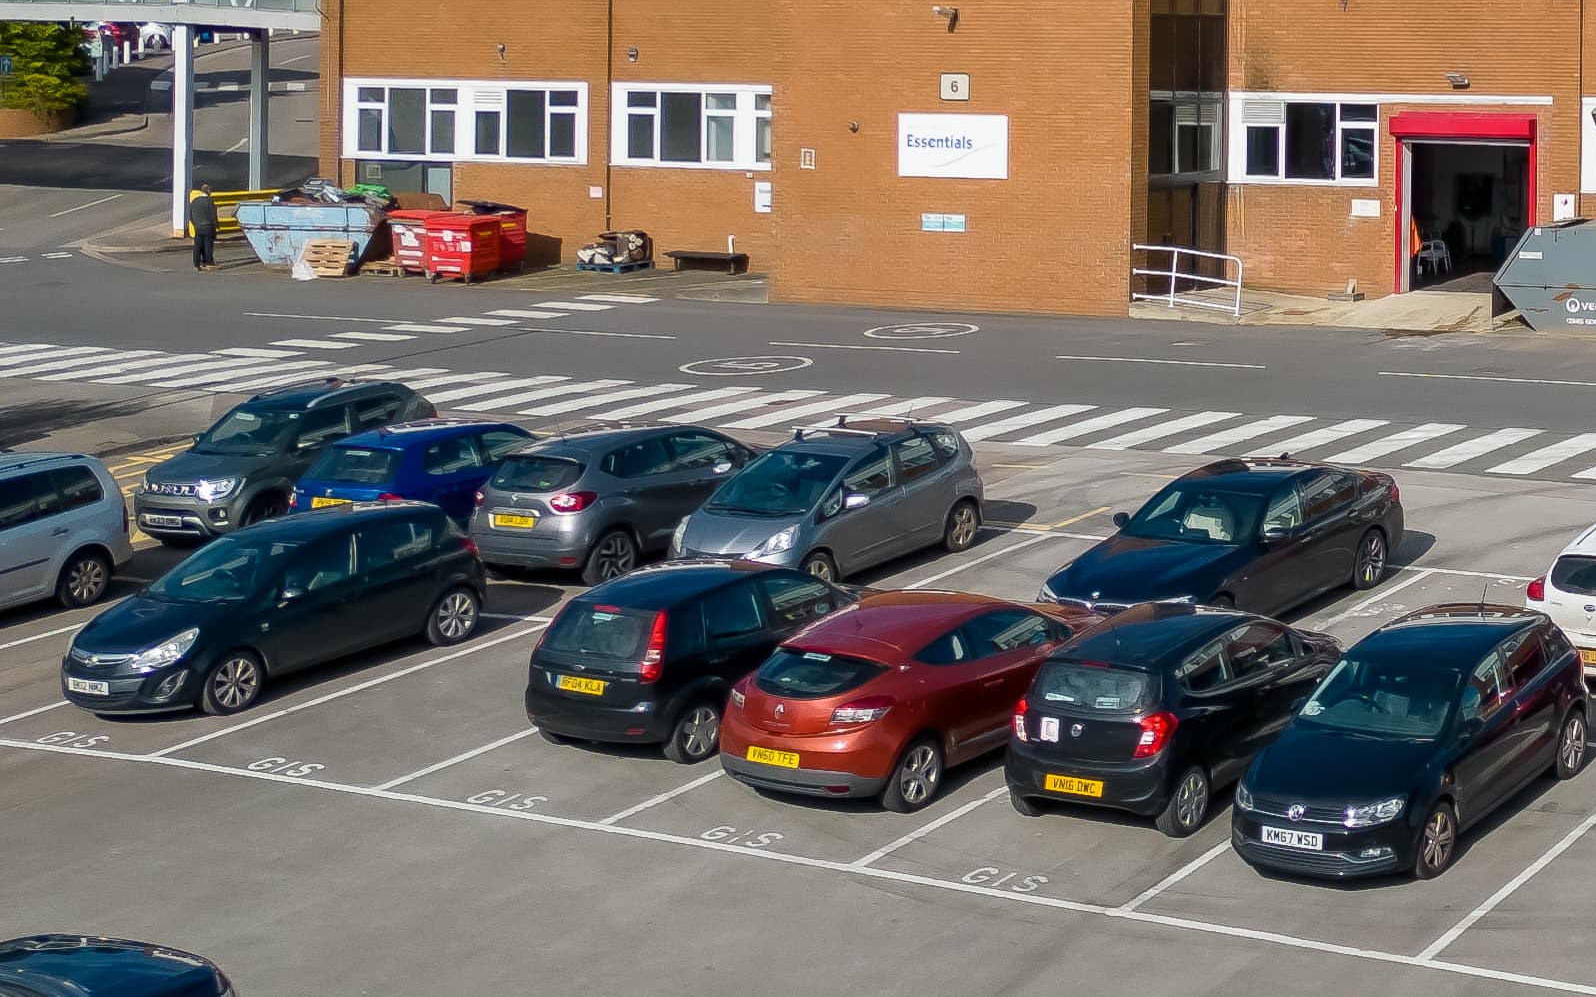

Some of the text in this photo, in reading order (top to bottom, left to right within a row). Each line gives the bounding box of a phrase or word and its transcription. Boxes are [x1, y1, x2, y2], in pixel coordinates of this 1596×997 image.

[950, 80, 959, 93] 6
[906, 134, 973, 150] Essentials
[778, 752, 796, 765] TFE
[1053, 777, 1075, 791] VN16
[1266, 829, 1294, 844] KM67
